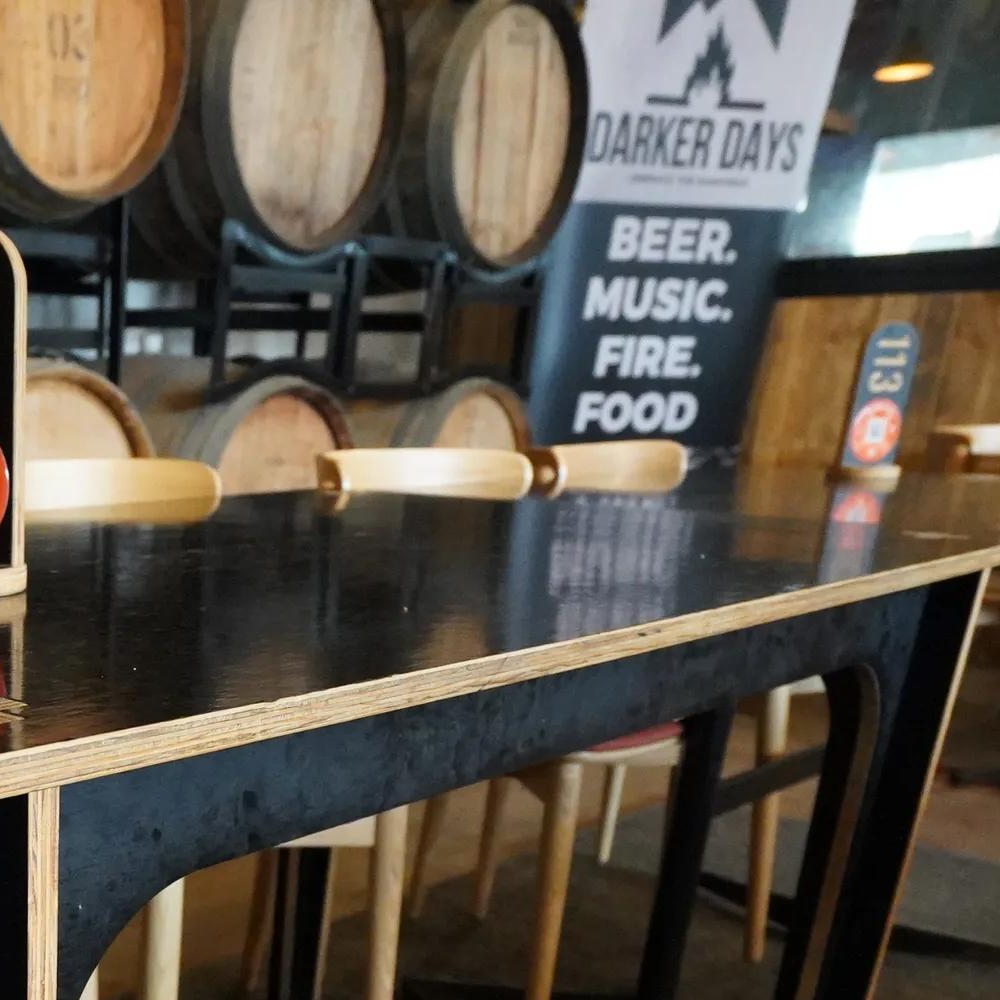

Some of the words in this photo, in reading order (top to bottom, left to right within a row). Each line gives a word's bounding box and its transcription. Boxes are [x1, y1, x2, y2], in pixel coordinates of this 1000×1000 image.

[588, 111, 715, 168] DARKER
[719, 118, 804, 172] DAYS
[607, 215, 737, 264] BEER.
[582, 275, 734, 323] MUSIC.
[593, 334, 702, 379] FIRE.
[868, 335, 912, 393] 113
[573, 390, 699, 434] FOOD
